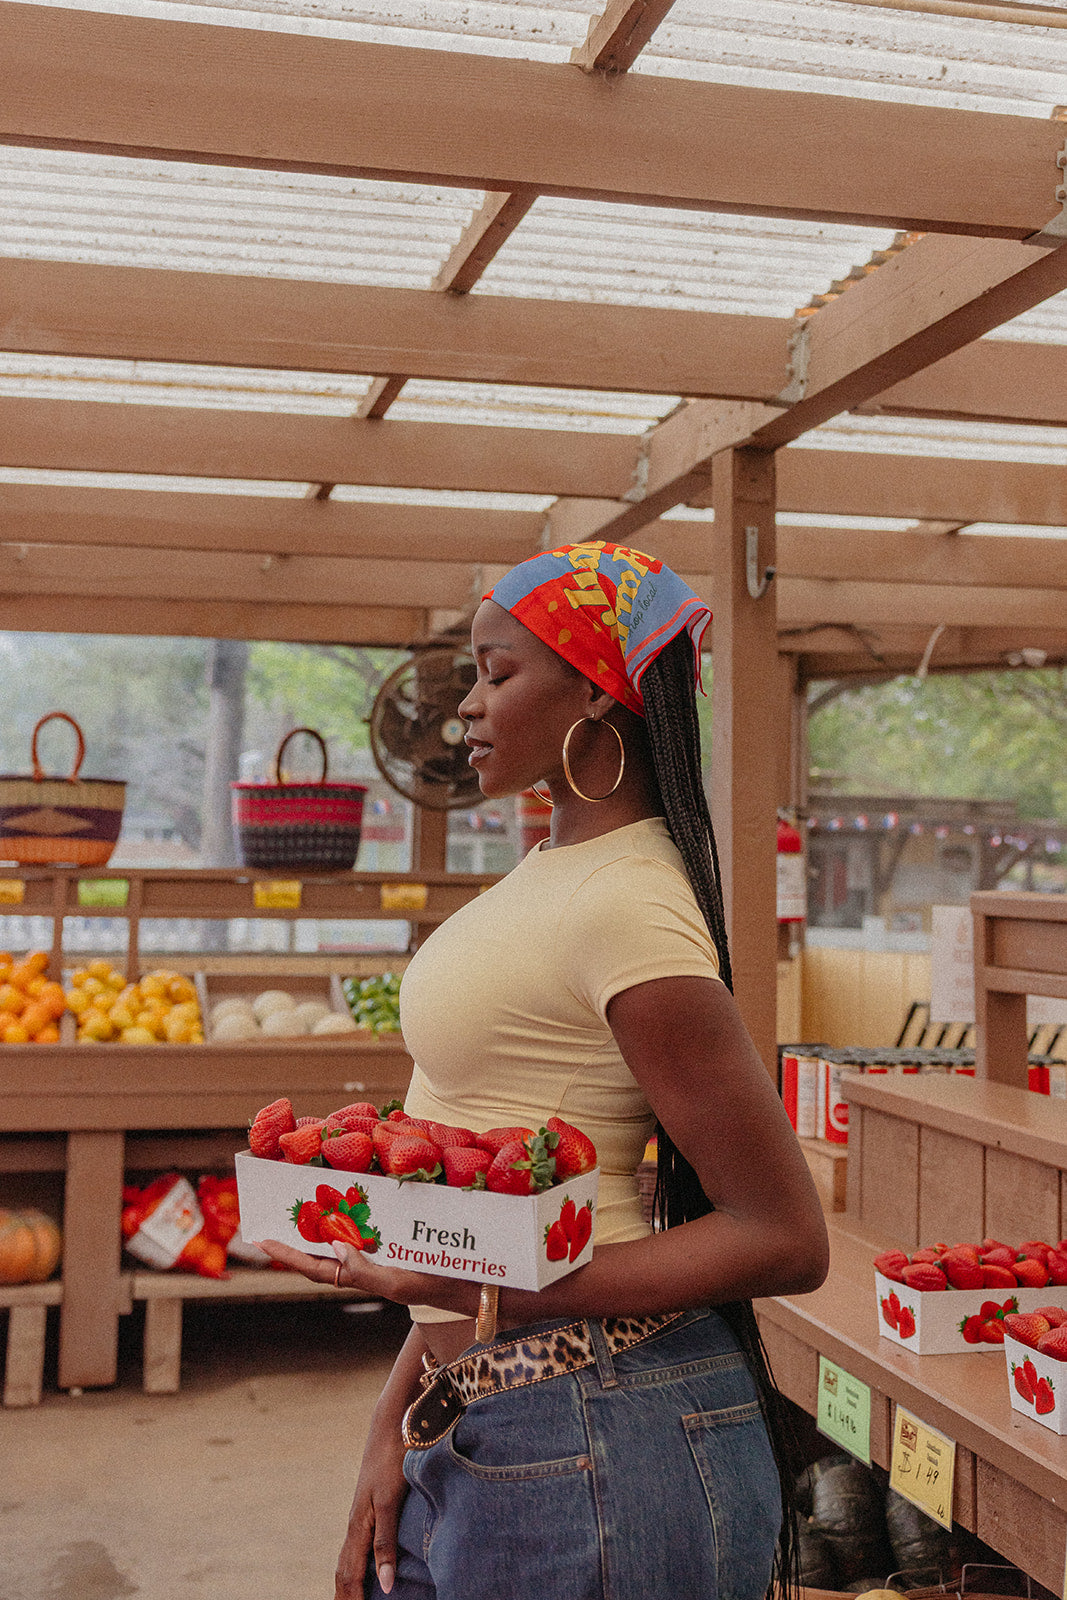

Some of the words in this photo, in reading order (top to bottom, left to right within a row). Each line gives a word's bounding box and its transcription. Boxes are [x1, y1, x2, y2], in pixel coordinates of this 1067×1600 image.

[638, 581, 657, 610] local
[411, 1220, 476, 1250] Fresh
[387, 1242, 507, 1277] Strawberries
